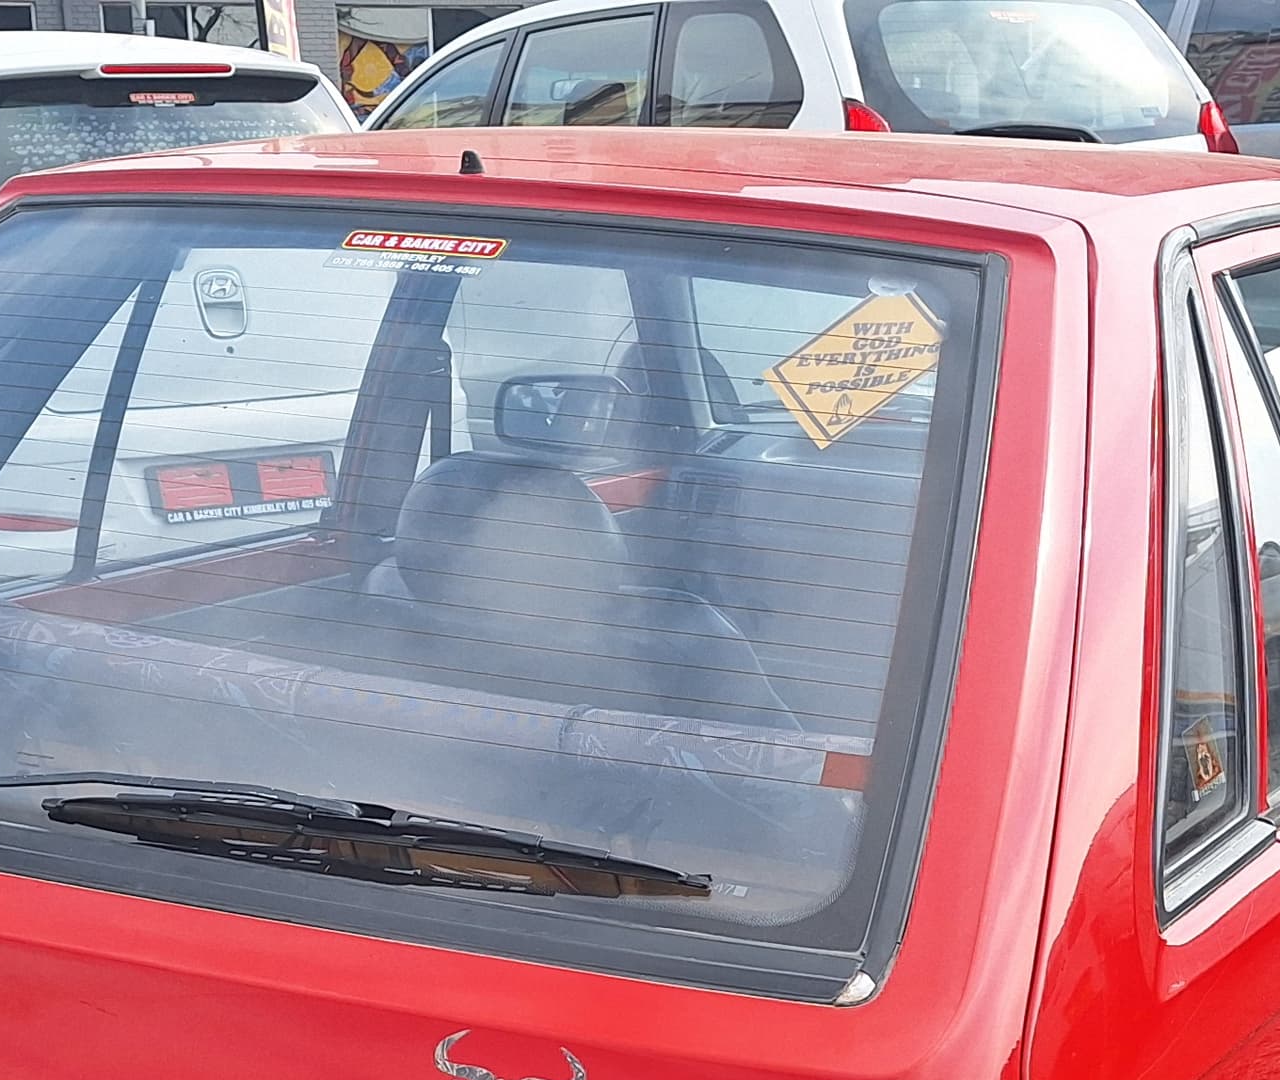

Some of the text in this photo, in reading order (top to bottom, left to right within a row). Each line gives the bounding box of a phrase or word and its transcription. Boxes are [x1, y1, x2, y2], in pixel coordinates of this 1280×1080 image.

[352, 234, 497, 255] CAR & BAKKIE CITY
[380, 251, 446, 263] KIMBERLEY
[431, 264, 455, 273] 405
[852, 321, 914, 336] WITH
[852, 335, 902, 350] GOD
[796, 343, 941, 367] EVERYTHING
[853, 365, 876, 377] IS
[805, 369, 912, 395] POSSIBLE
[223, 506, 242, 517] CITY
